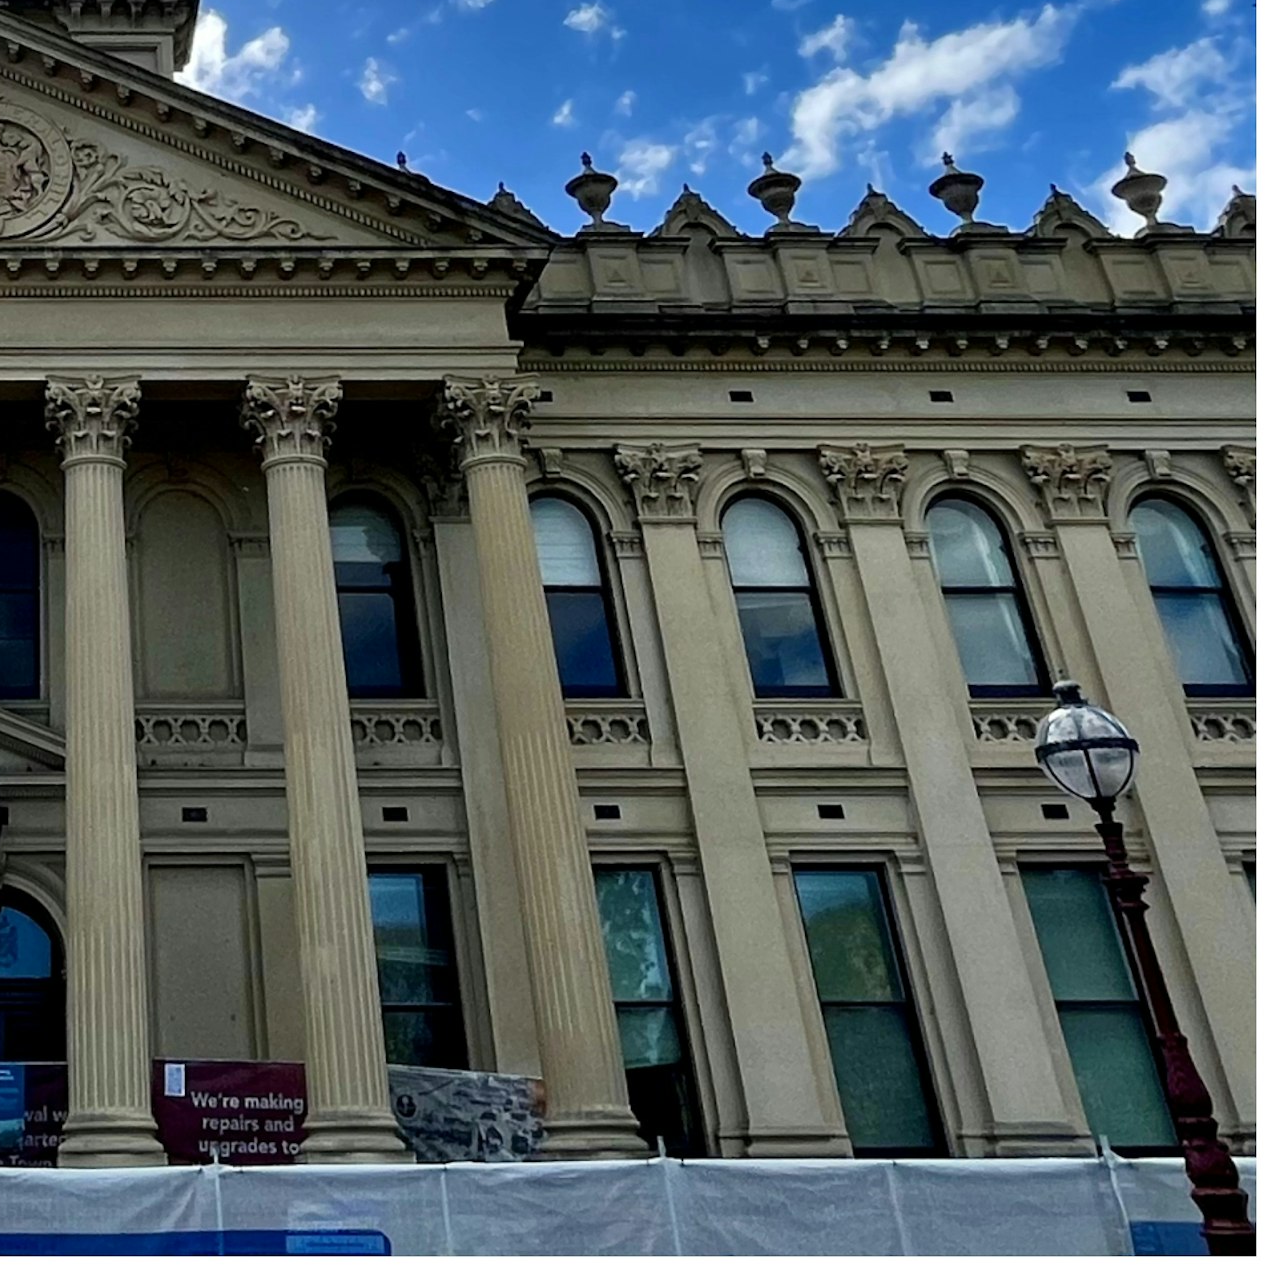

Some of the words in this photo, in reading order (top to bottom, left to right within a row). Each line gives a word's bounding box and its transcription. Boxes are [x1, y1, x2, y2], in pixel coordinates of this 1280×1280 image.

[190, 1091, 240, 1108] We're
[244, 1092, 304, 1115] making
[202, 1114, 260, 1135] repairs
[264, 1114, 295, 1132] and
[199, 1137, 278, 1158] upgrades
[282, 1141, 301, 1155] to
